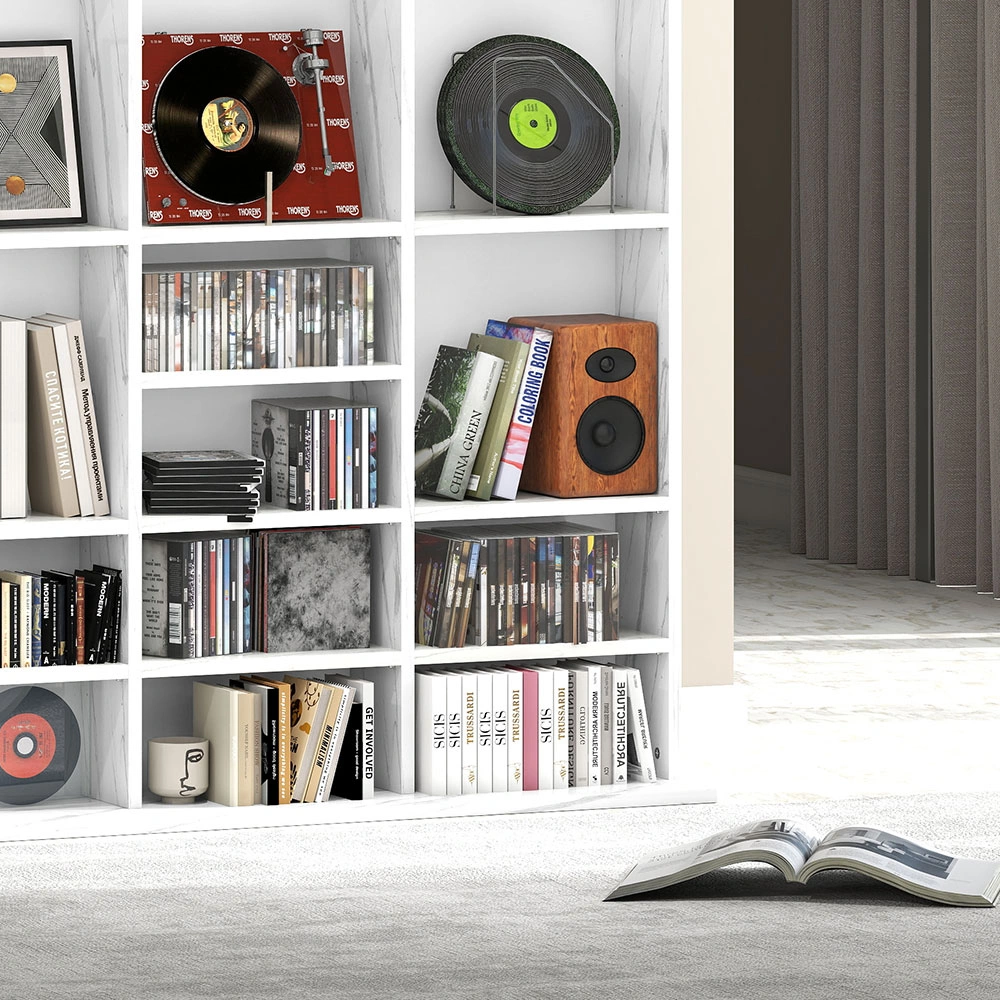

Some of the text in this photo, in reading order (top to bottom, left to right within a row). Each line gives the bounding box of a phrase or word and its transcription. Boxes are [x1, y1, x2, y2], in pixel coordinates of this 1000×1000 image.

[170, 32, 340, 46] THORENS THORENS THORENS ORENS
[327, 119, 350, 129] THORENS
[145, 167, 158, 177] RENS
[150, 205, 359, 221] RENS THORENS THORENS THORENS THORENS
[517, 338, 550, 424] COLORING BOOK
[82, 388, 90, 412] Метод
[45, 370, 72, 480] СПАСИТЕ КОТИКА!
[450, 410, 482, 494] CHINA GREEN
[96, 581, 107, 617] MODERN
[433, 713, 445, 749] SICIS
[449, 712, 460, 748] SICIS
[466, 692, 474, 745] TRUSSARDI
[480, 711, 491, 746] SICIS
[495, 710, 506, 745] SICIS
[512, 690, 520, 742] TRUSSARDI
[541, 708, 552, 743] SICIS
[558, 687, 566, 740] TRUSSARDI
[316, 724, 333, 768] MINIMALISM
[365, 707, 374, 780] GET INVOLVED
